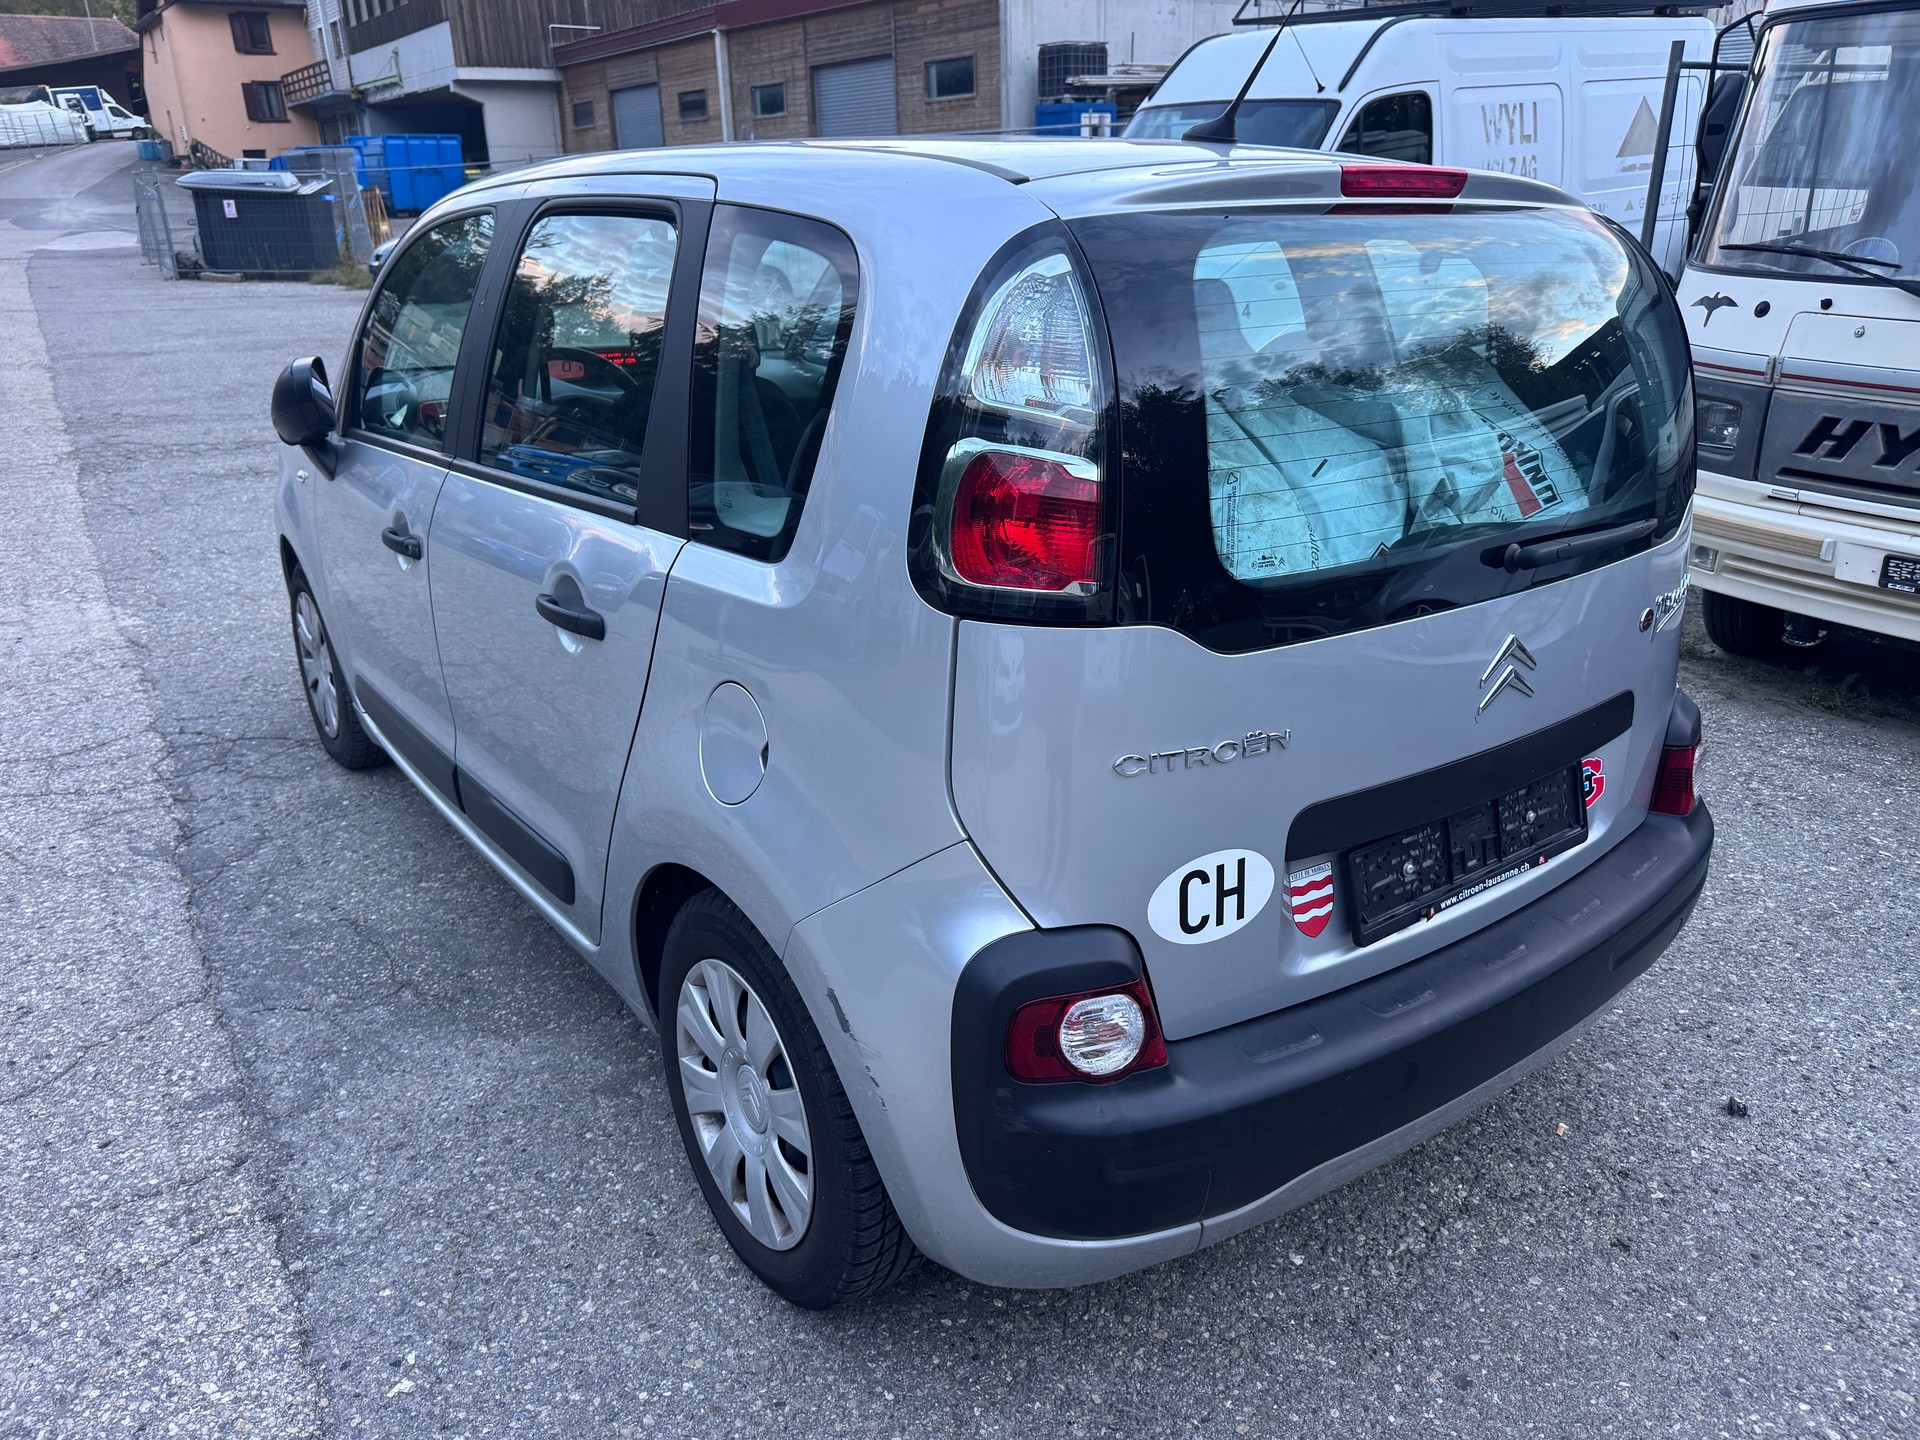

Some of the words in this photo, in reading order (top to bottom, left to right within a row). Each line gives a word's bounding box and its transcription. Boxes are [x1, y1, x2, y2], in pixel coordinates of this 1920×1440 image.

[1792, 414, 1920, 475] HY
[1112, 729, 1292, 777] CITROËN
[1179, 857, 1246, 935] CH
[1440, 862, 1531, 910] www.citroen-lausanne.ch
